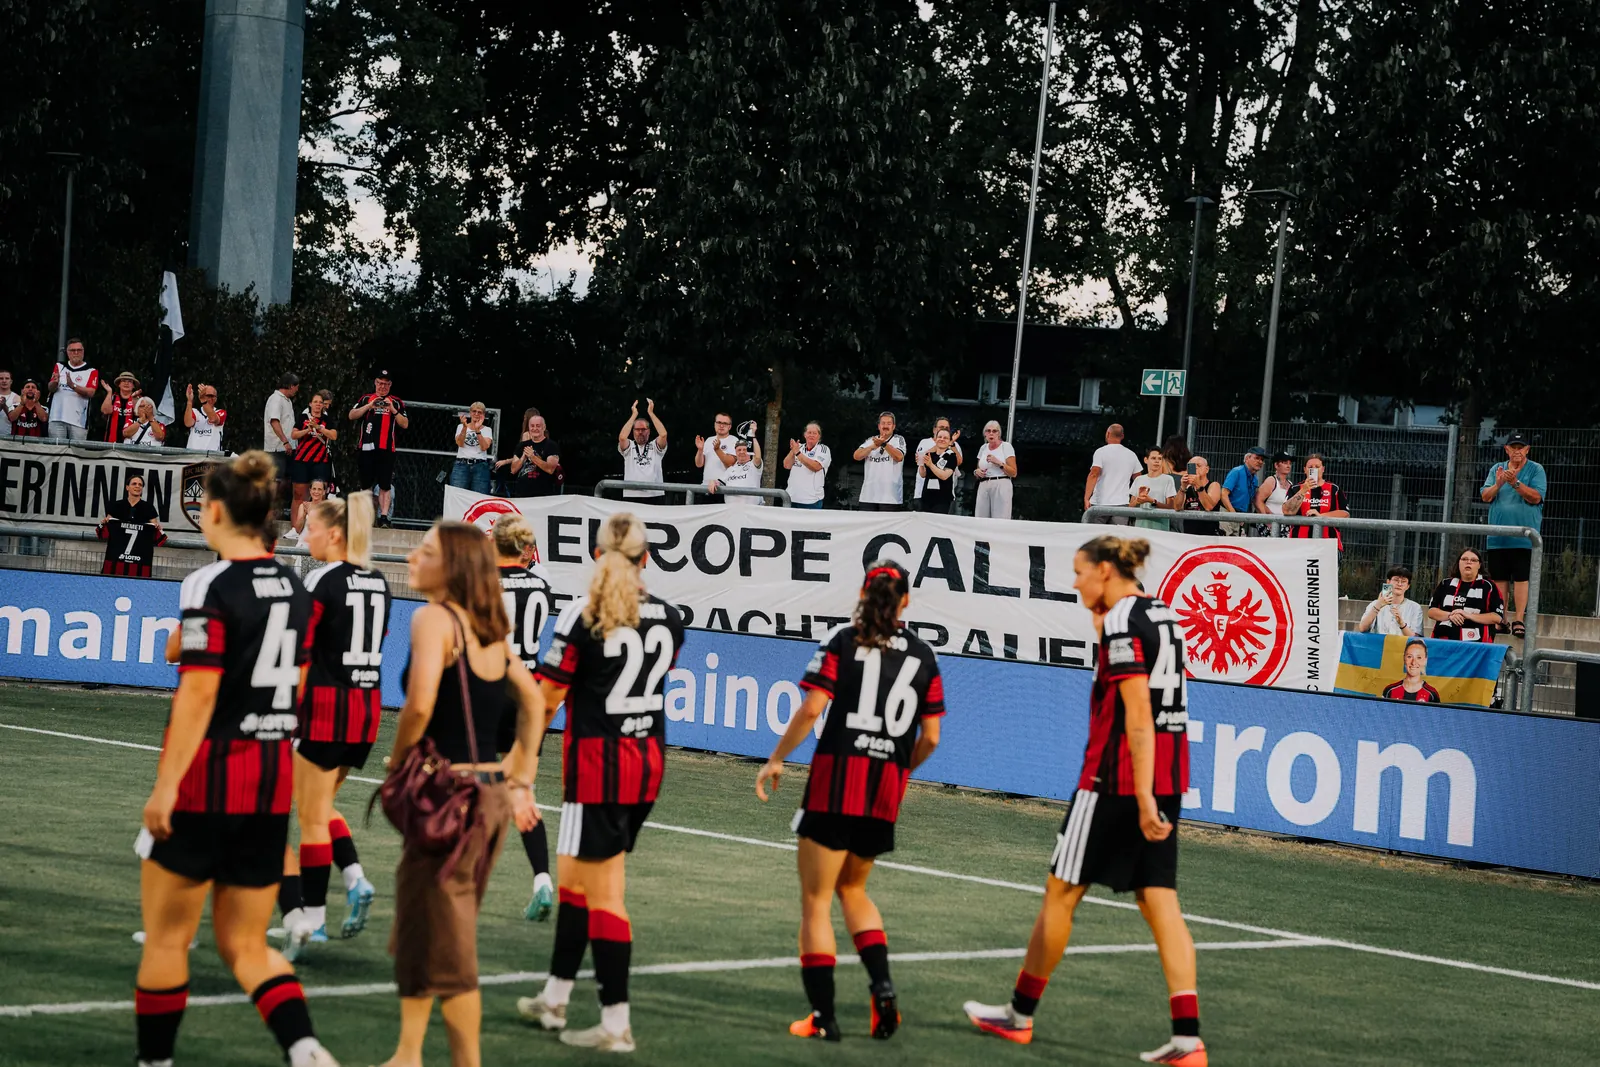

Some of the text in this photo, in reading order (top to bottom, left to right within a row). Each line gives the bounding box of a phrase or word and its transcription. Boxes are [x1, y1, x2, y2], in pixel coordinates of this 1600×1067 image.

[120, 522, 143, 531] MEMETI
[124, 528, 139, 555] 7
[862, 533, 1078, 603] CALL
[1307, 558, 1320, 644] ADLERINNEN
[251, 601, 301, 710] 4
[342, 592, 386, 667] 11
[1307, 647, 1320, 680] MAIN
[603, 625, 674, 715] 22
[846, 646, 922, 738] 16
